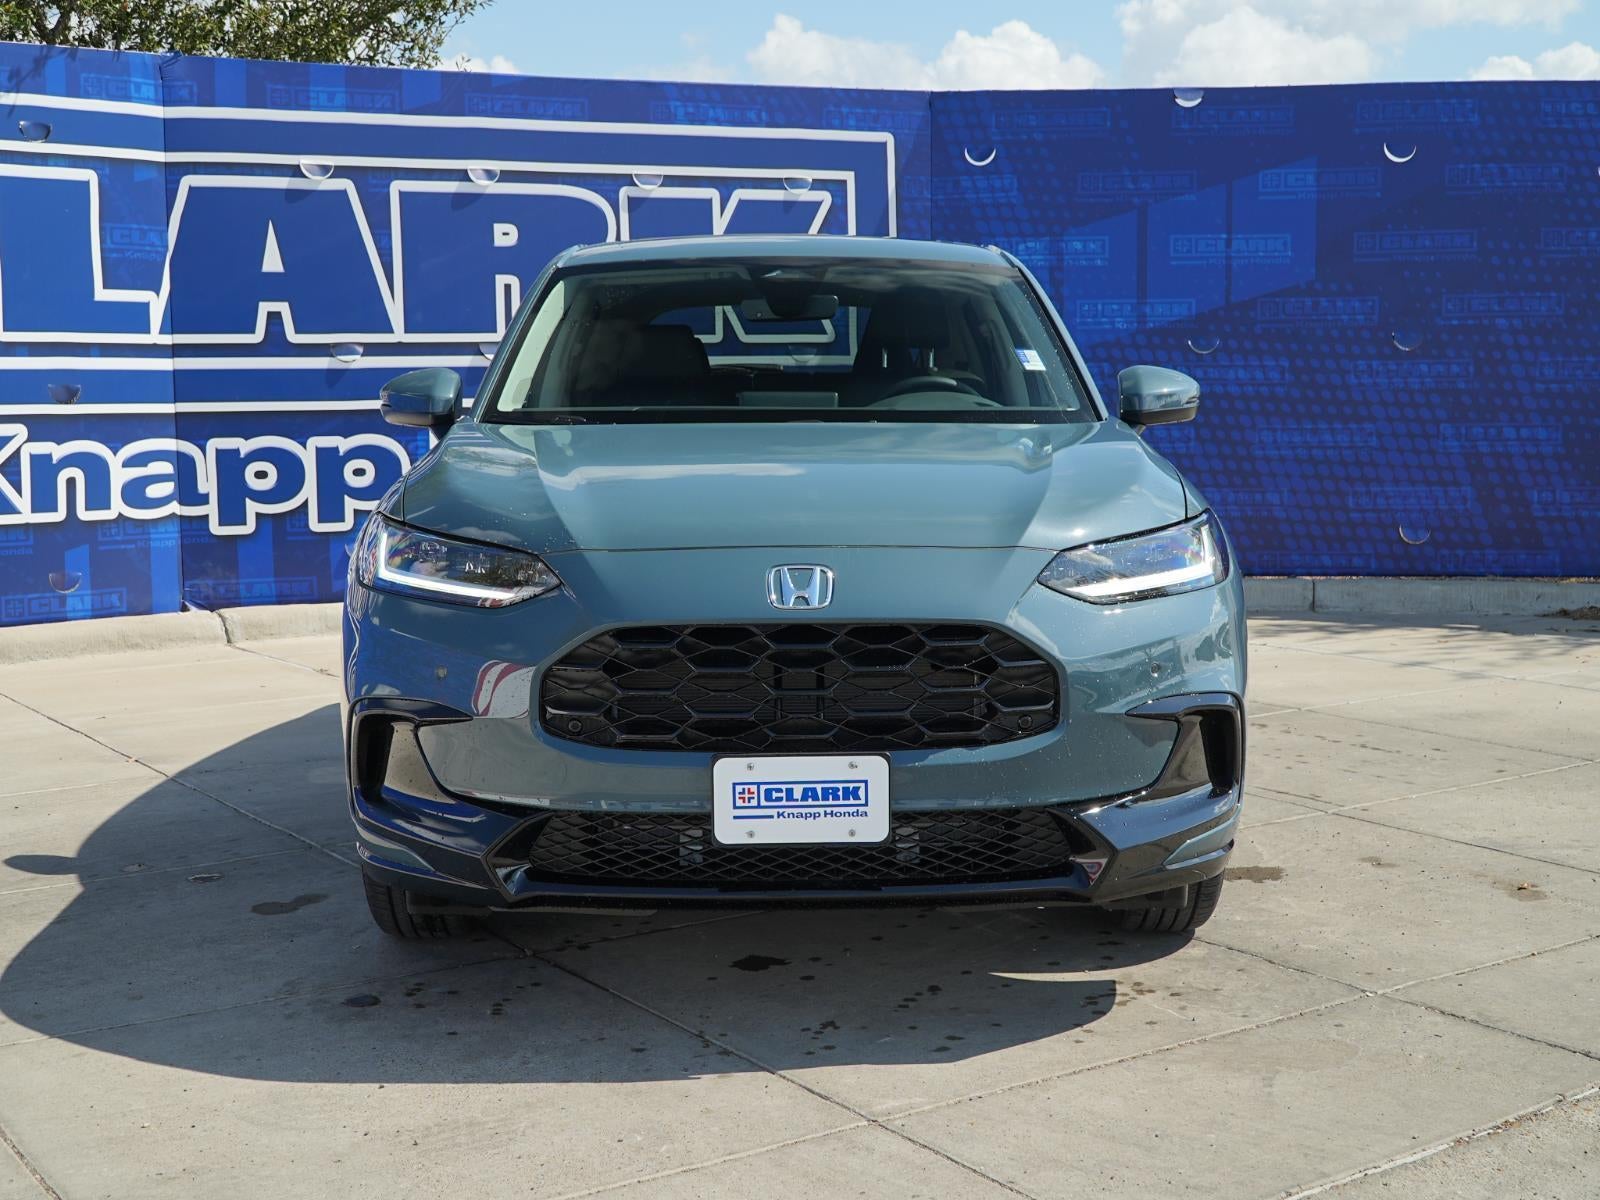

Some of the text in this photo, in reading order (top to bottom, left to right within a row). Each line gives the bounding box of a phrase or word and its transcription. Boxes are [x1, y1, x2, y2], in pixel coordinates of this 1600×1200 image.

[764, 785, 862, 803] CLARK
[776, 809, 868, 820] Knapp Honda
